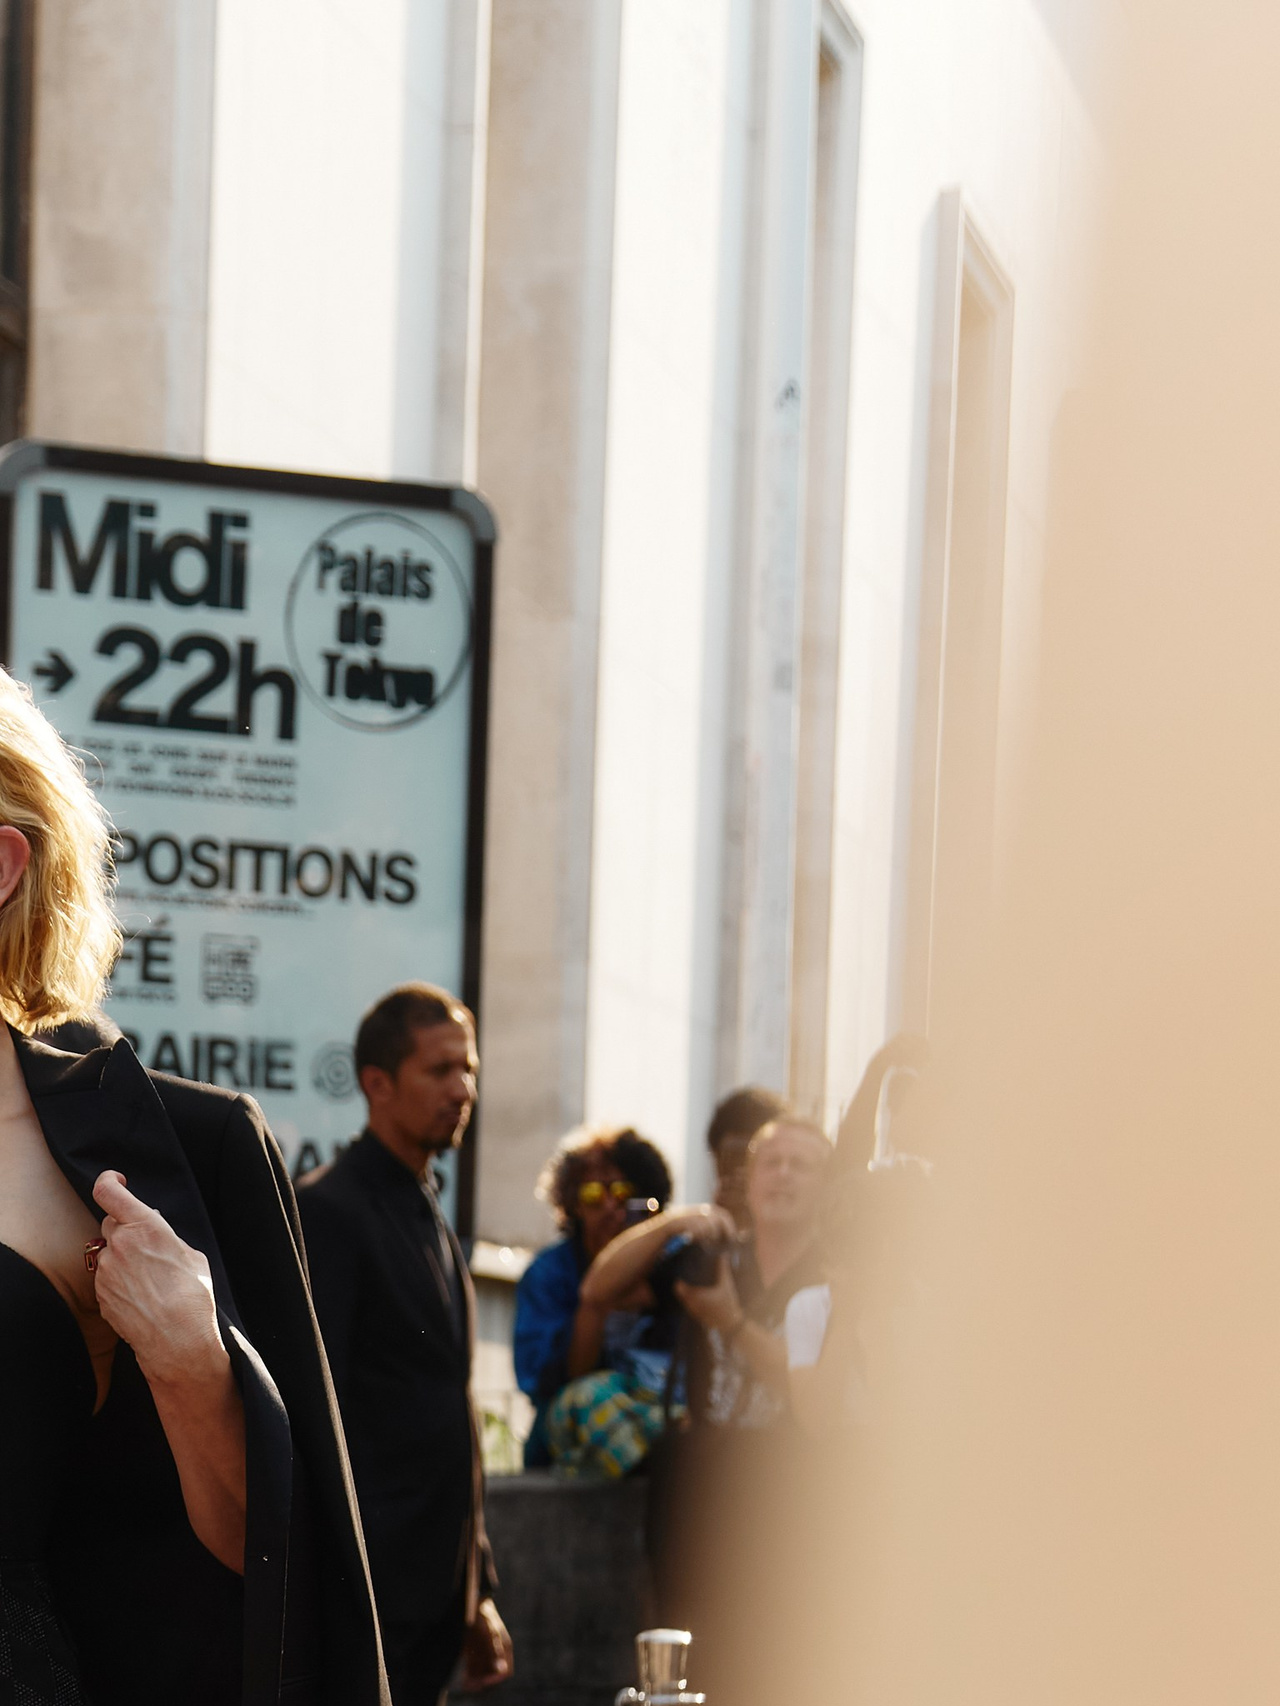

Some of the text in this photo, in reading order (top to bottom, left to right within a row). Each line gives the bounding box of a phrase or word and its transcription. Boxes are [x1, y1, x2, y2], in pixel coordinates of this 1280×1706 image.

[34, 490, 252, 611] Midi
[316, 540, 433, 601] Palais
[338, 595, 384, 647] de
[92, 624, 298, 740] 22h
[107, 832, 418, 904] POSITIONS
[110, 912, 174, 985] FÉ
[122, 1026, 296, 1091] AIRIE
